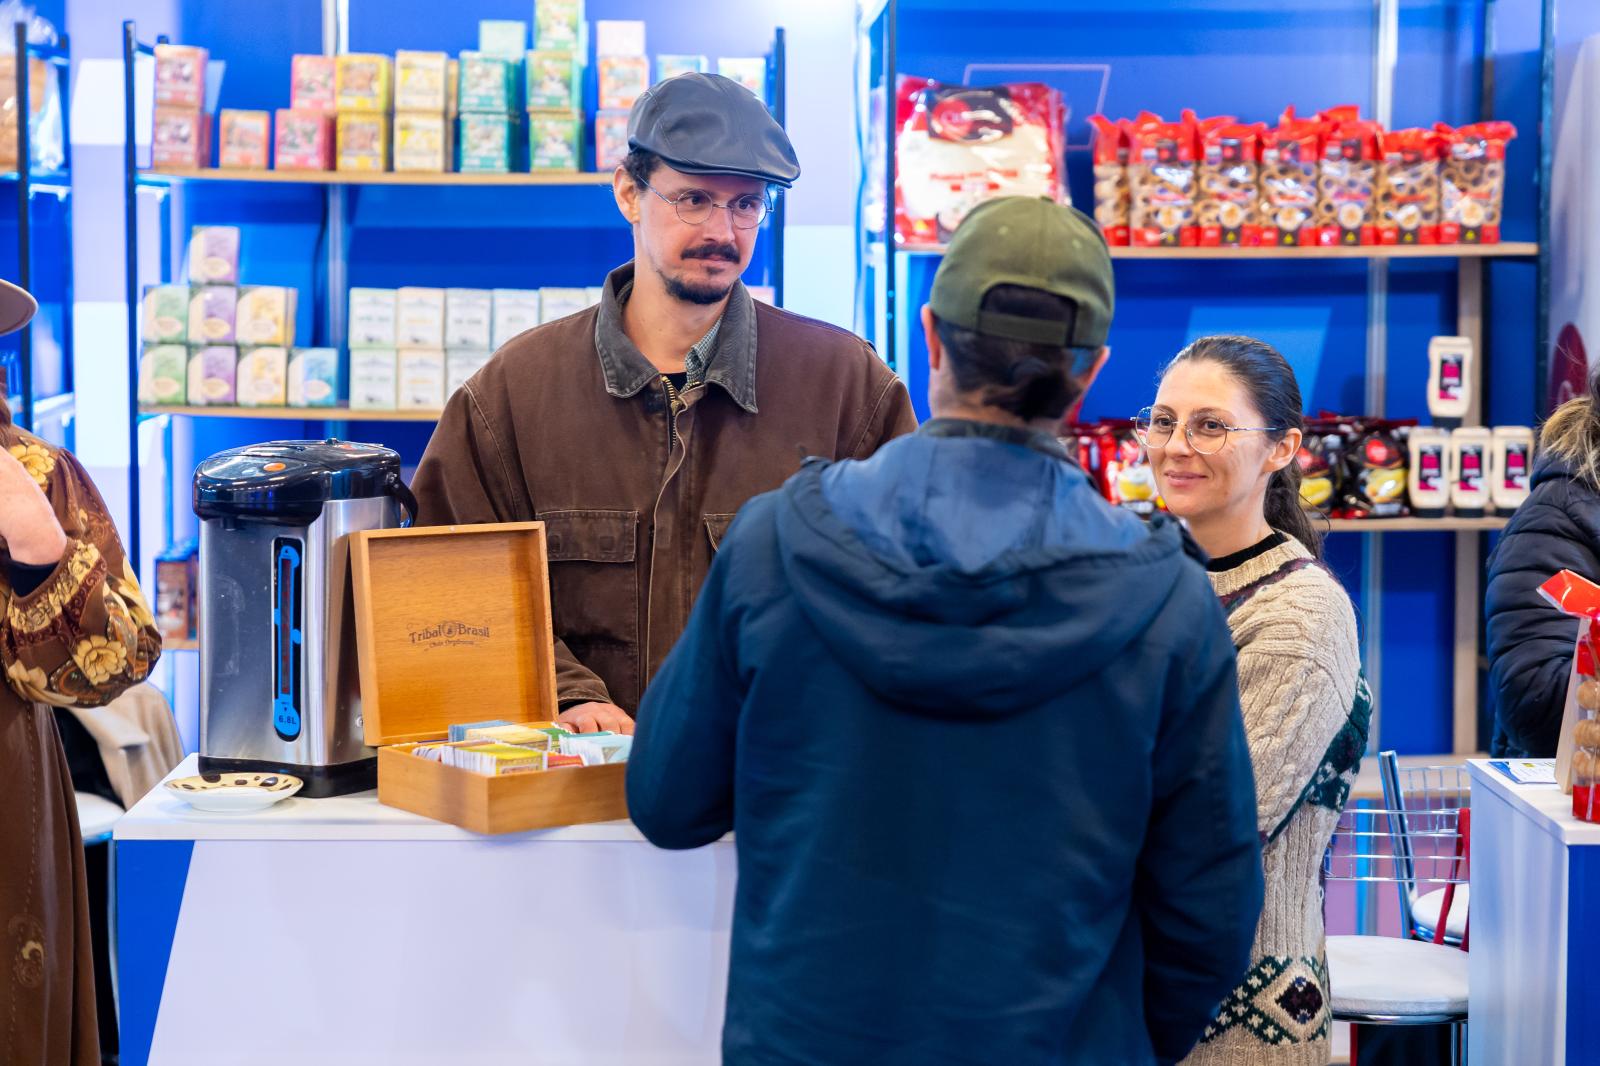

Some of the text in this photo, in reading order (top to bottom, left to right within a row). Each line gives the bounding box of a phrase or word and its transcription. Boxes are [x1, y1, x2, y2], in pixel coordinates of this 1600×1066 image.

[409, 624, 490, 643] Tribal Brasil
[278, 715, 297, 725] 6.8L
